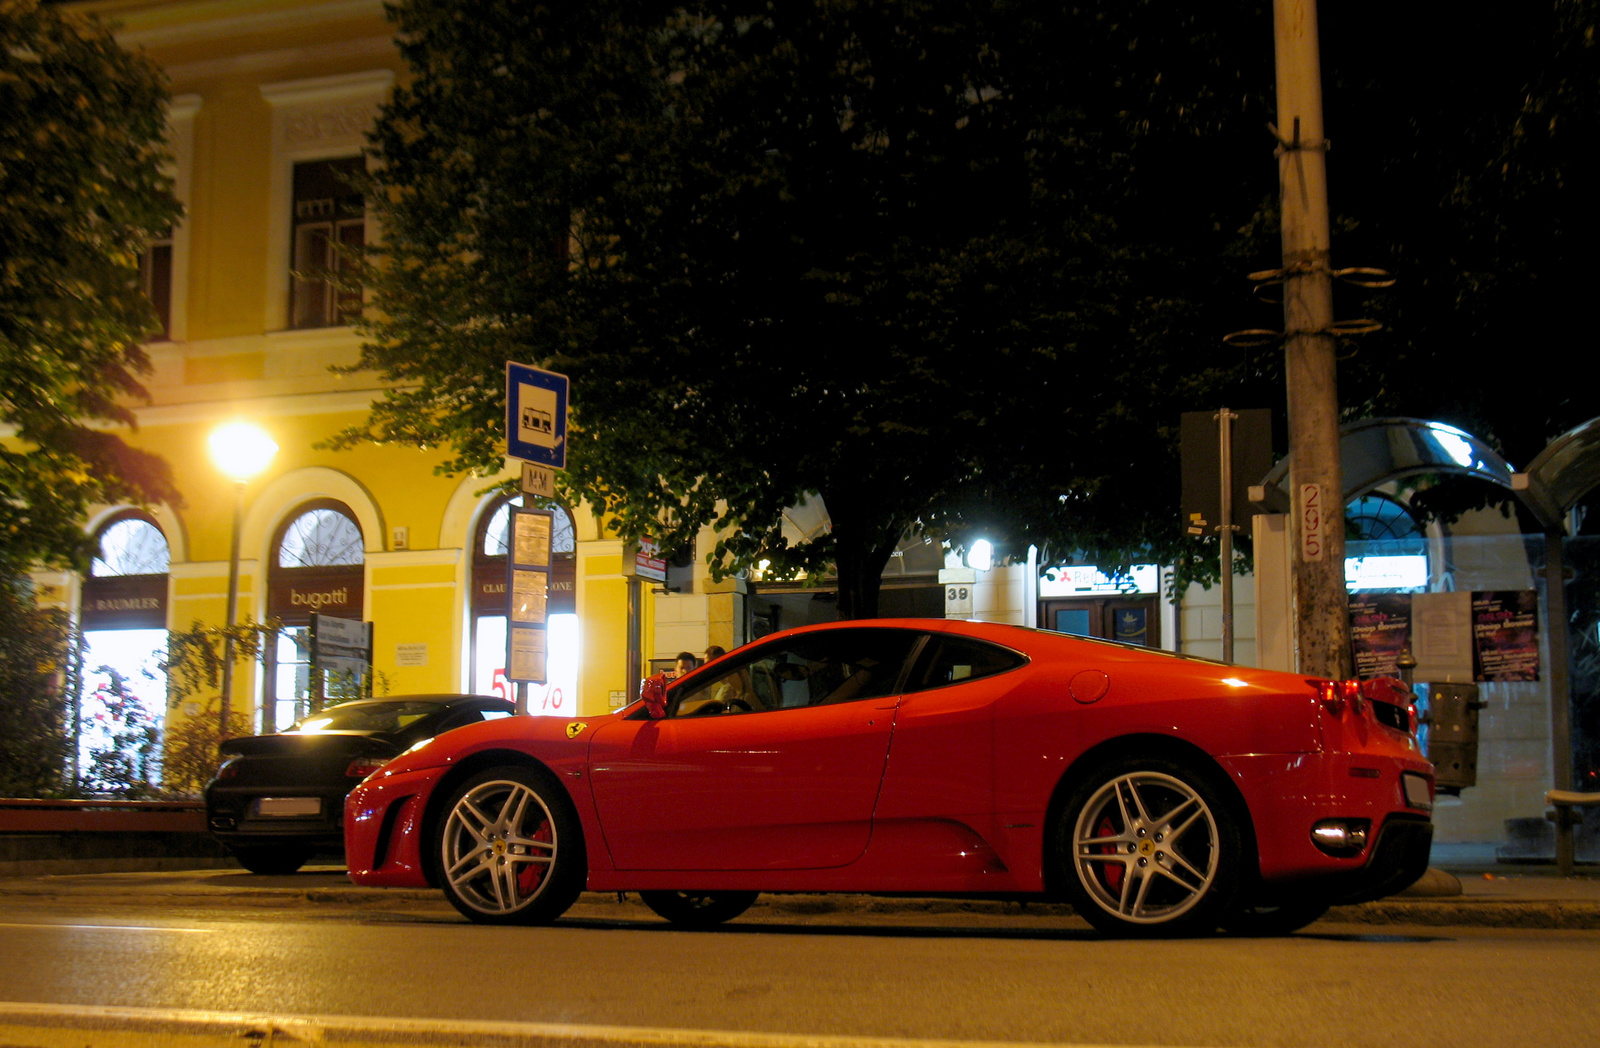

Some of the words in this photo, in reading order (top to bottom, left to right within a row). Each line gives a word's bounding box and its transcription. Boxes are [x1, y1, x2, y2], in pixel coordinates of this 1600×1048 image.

[1304, 485, 1320, 556] 295
[291, 587, 348, 609] bugatti
[947, 587, 968, 601] 39
